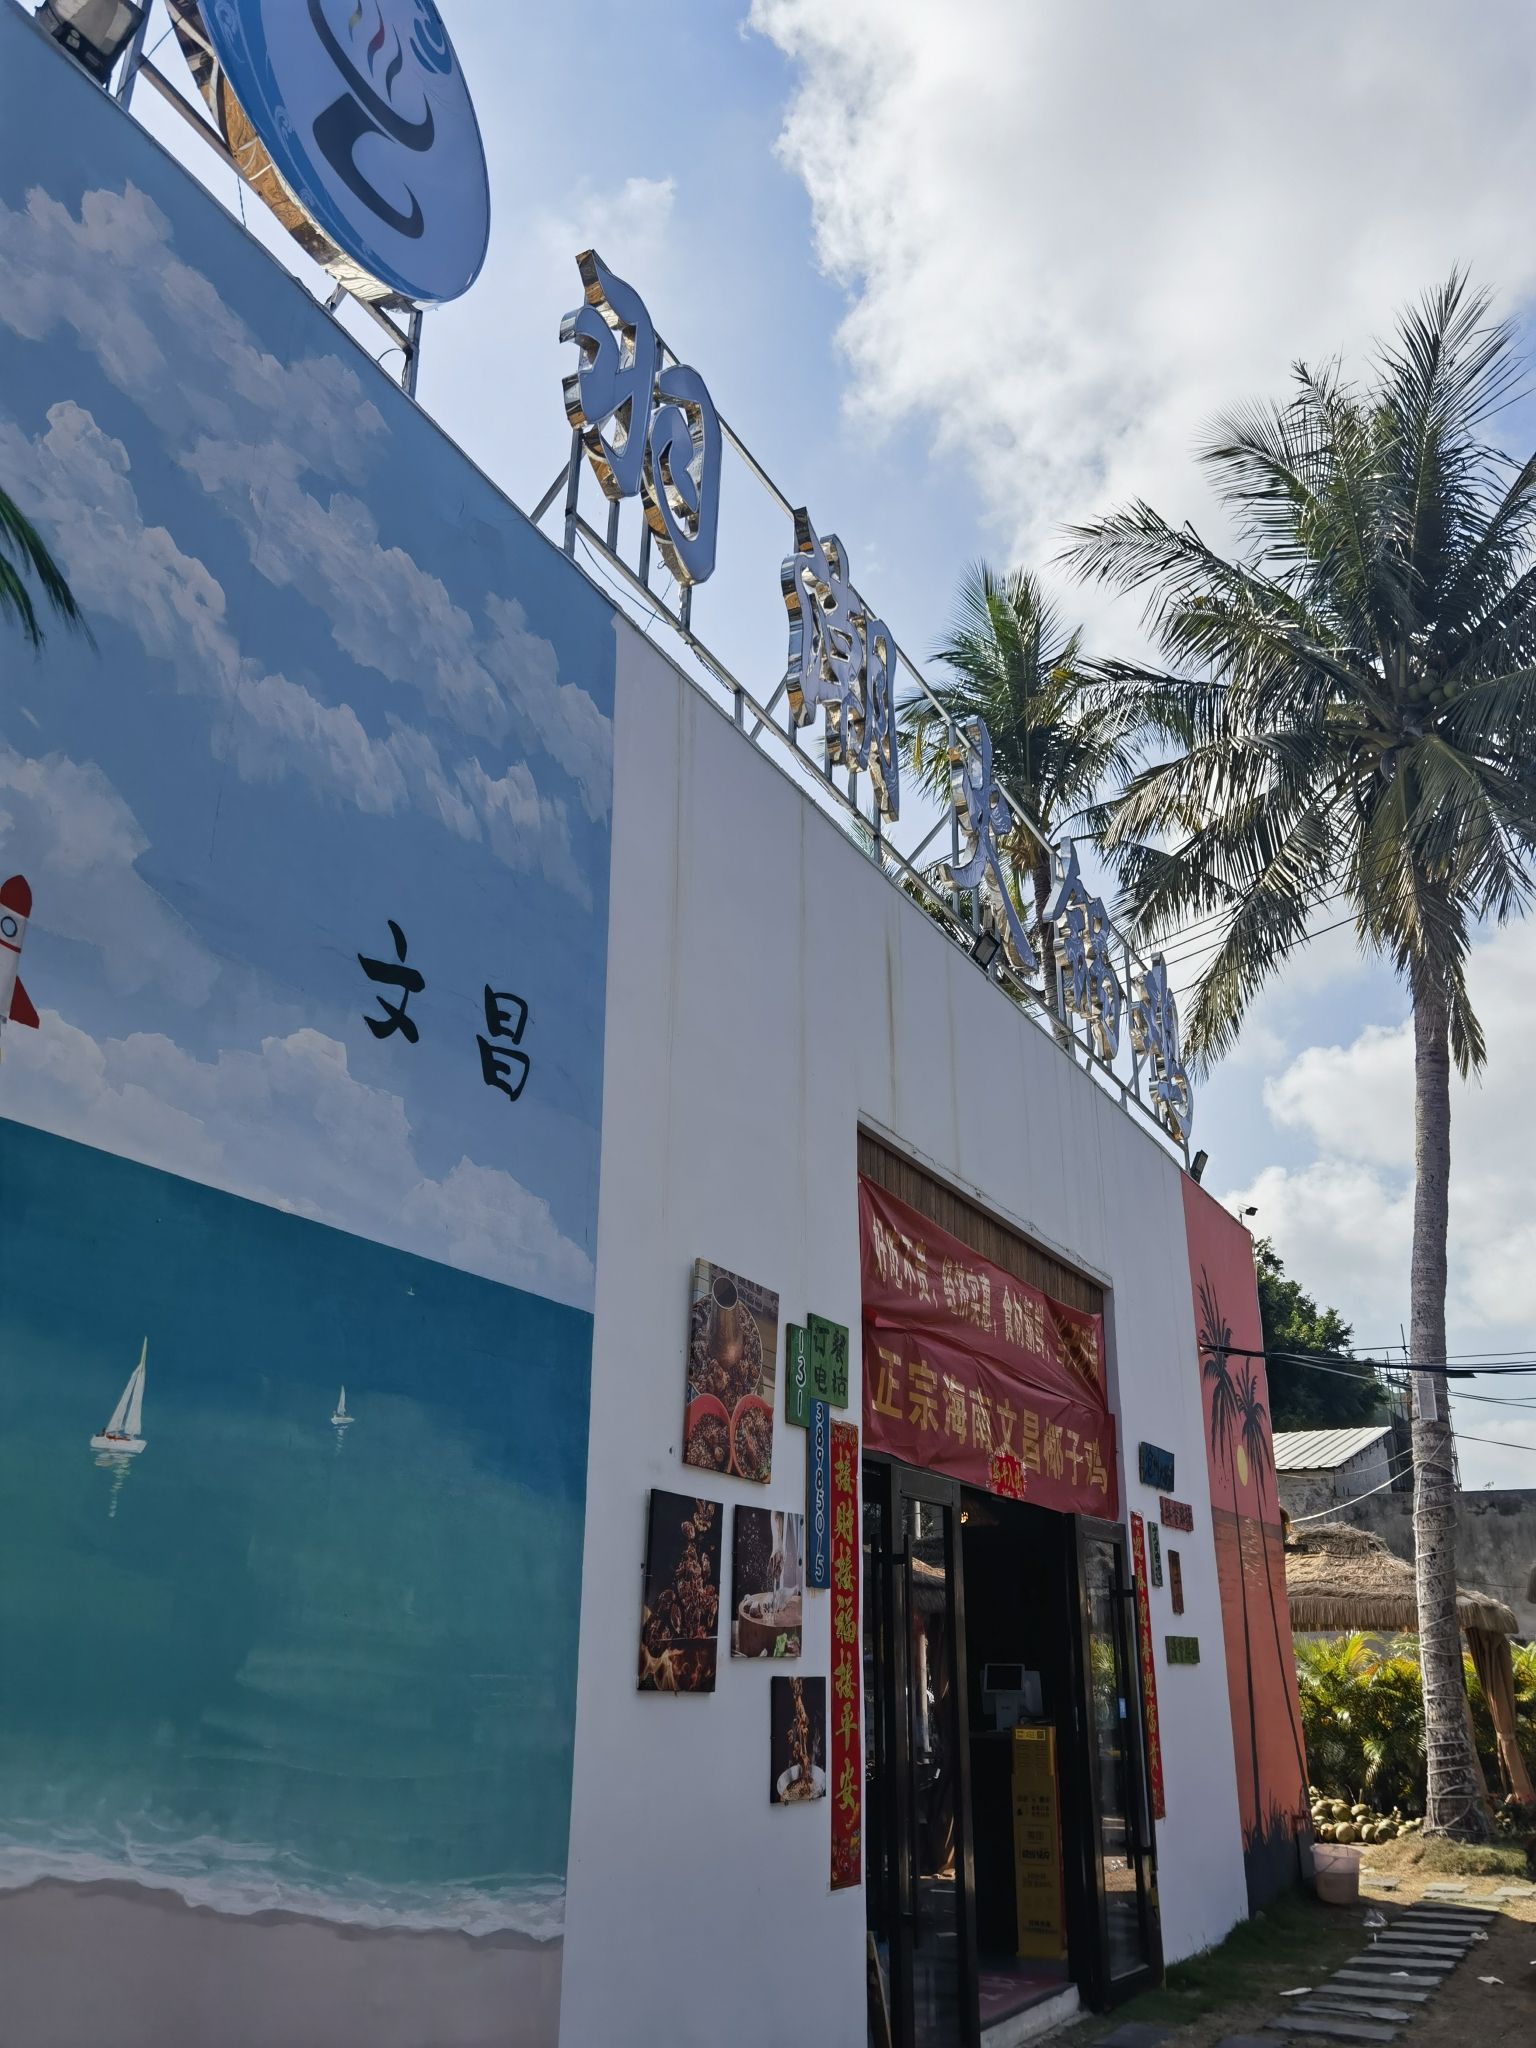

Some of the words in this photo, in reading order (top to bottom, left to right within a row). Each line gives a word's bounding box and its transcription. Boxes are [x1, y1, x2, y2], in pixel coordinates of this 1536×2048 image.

[357, 919, 530, 1101] 文昌
[795, 1328, 806, 1418] 131
[813, 1325, 846, 1364] 订餐
[814, 1366, 848, 1397] 电话
[872, 1347, 1108, 1494] 正宗海南文昌椰子鸡
[815, 1401, 825, 1582] 38985015
